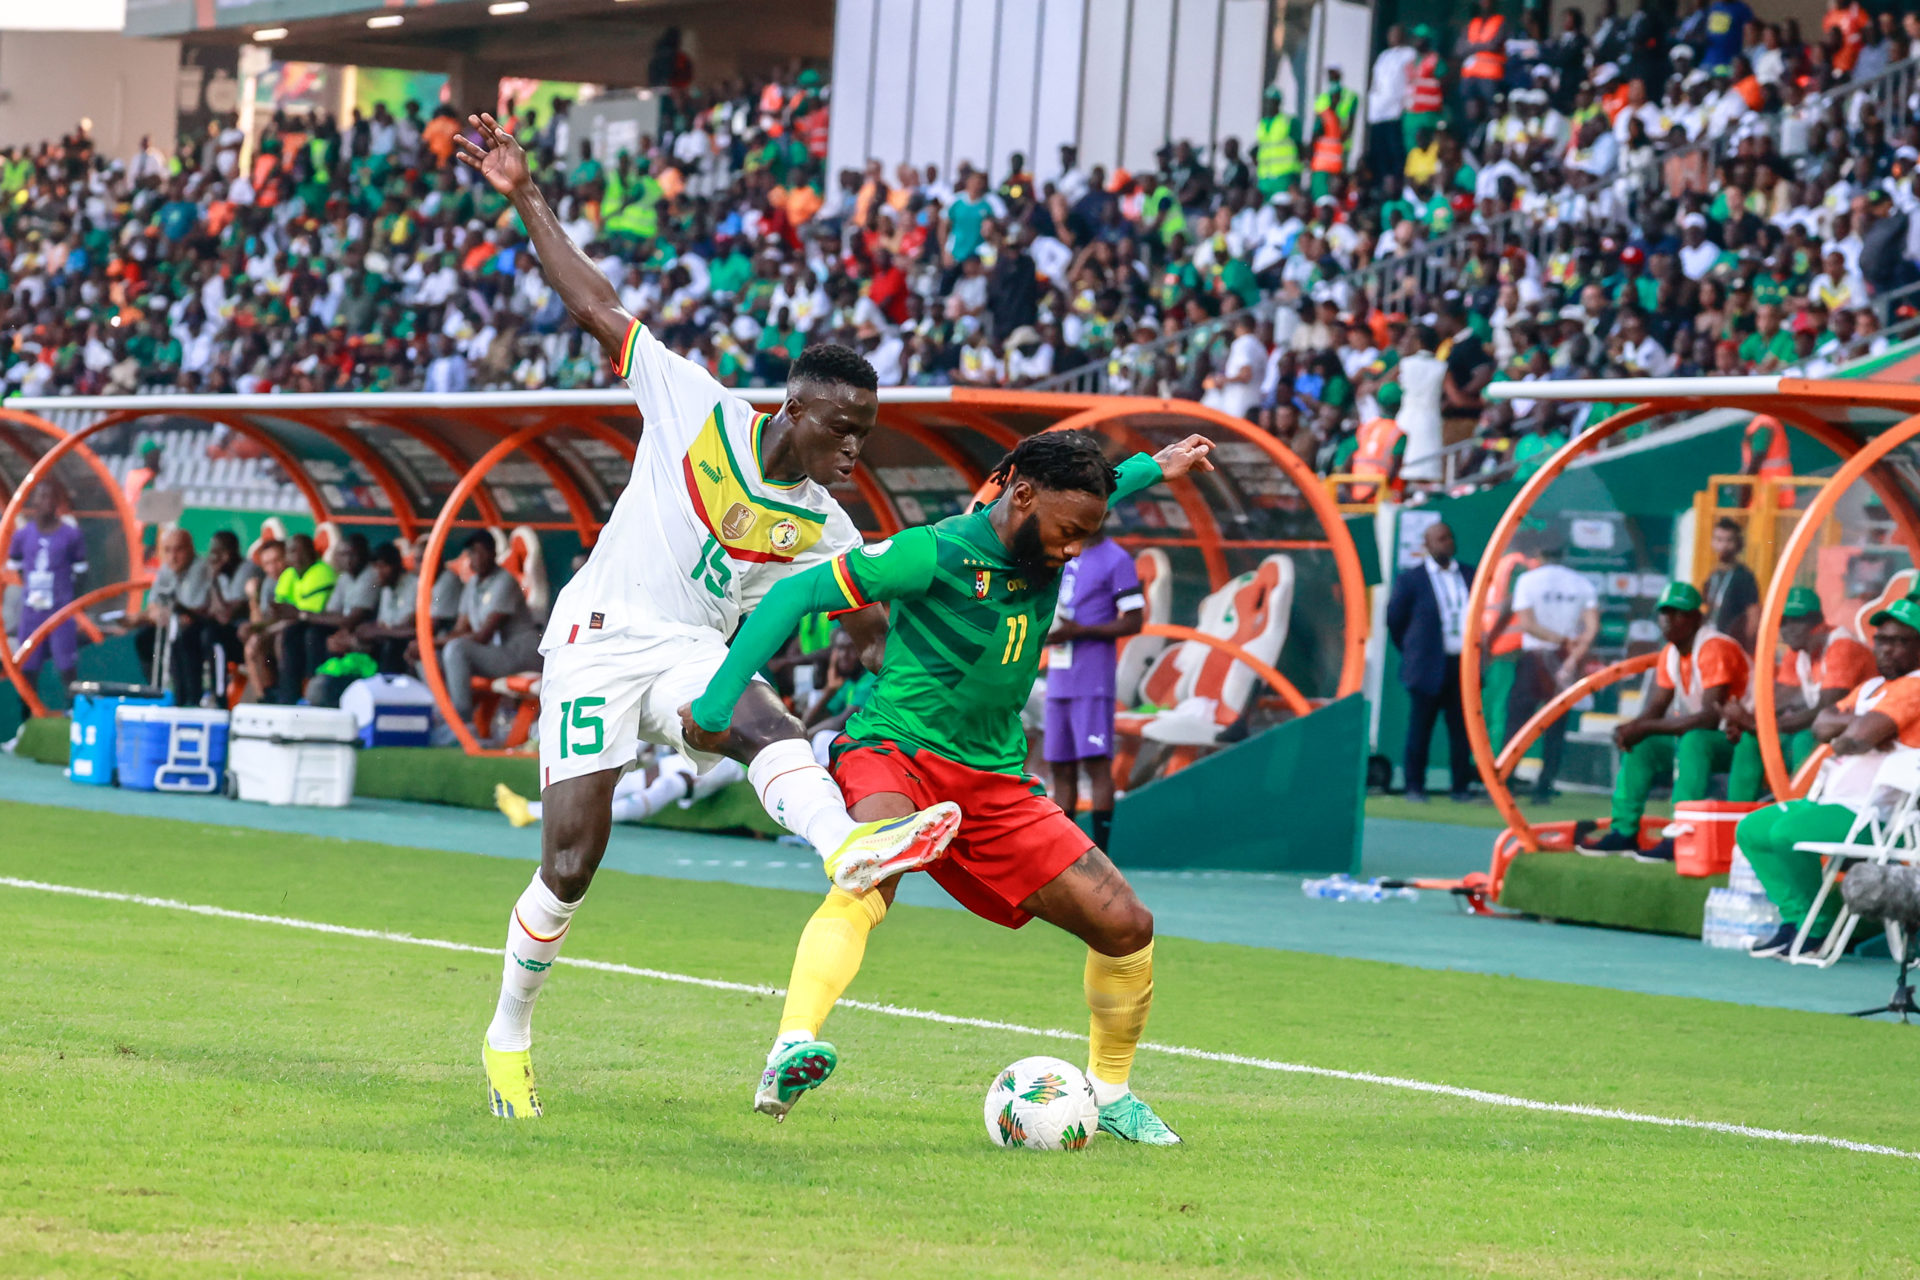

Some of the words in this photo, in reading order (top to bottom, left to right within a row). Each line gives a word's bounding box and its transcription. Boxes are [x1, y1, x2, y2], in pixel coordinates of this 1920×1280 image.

[699, 460, 720, 484] PUMA
[691, 532, 732, 599] 15
[1001, 614, 1028, 665] 11
[560, 696, 606, 759] 15
